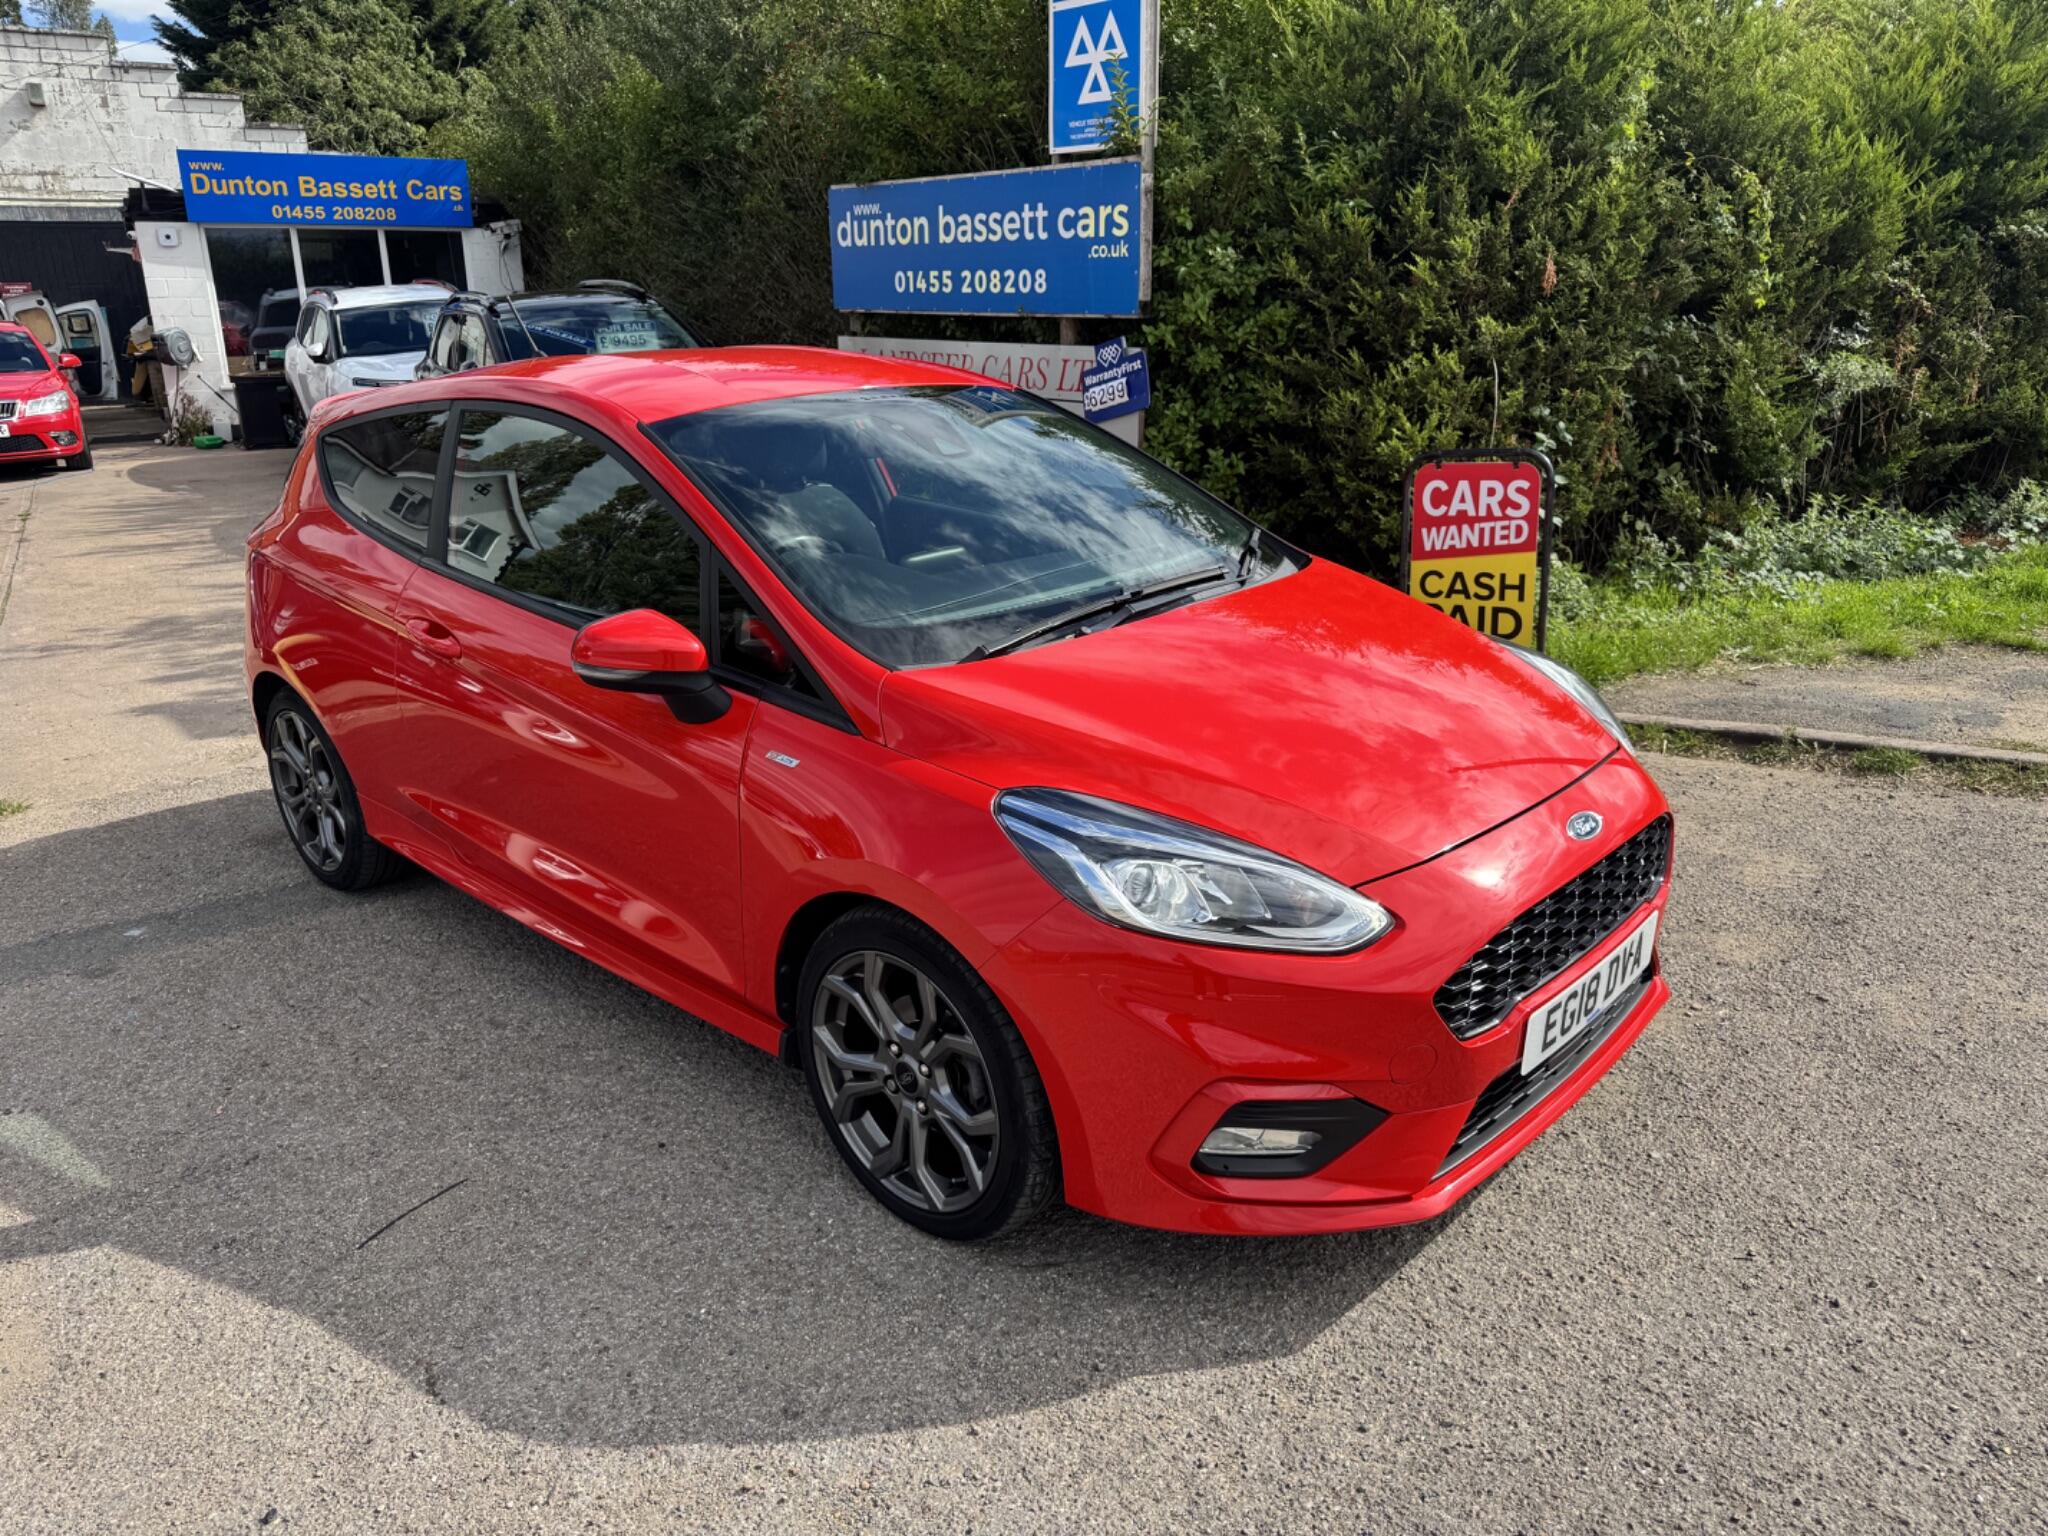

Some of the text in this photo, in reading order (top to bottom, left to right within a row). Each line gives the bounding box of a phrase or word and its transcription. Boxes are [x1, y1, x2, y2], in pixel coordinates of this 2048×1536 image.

[188, 160, 225, 171] www.
[189, 173, 464, 201] Dunton Bassett Cars
[271, 204, 398, 221] 01455 208208
[852, 203, 883, 216] www.
[836, 202, 1130, 248] dunton bassett cars
[1088, 240, 1129, 259] .co.uk
[894, 268, 1048, 294] 01455 208208
[624, 321, 652, 332] SALE
[1084, 359, 1142, 387] WarrantyFirst
[1421, 479, 1532, 518] CARS
[1420, 518, 1530, 552] WANTED
[1419, 570, 1526, 603] CASH
[1541, 931, 1645, 1054] EG18 DVA
